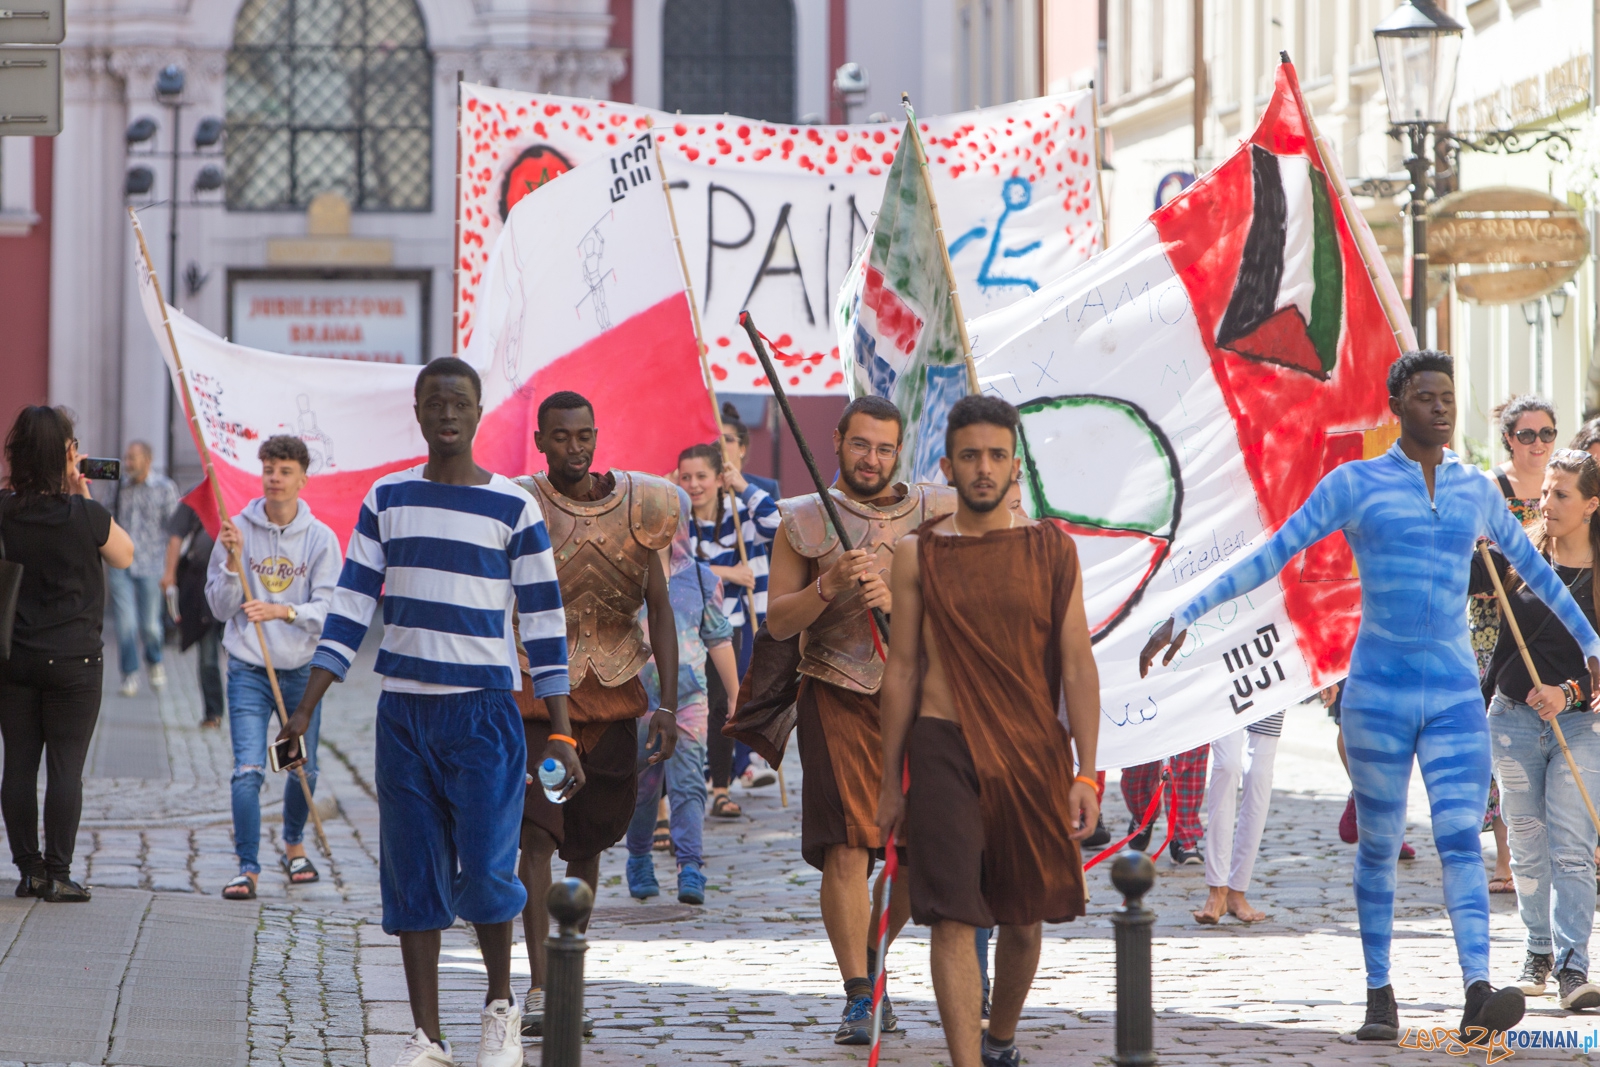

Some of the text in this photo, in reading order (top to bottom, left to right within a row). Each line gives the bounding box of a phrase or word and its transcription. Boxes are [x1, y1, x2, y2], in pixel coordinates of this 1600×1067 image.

[289, 324, 363, 344] BRAMA
[1165, 529, 1254, 583] Frieden
[277, 562, 308, 580] Rock
